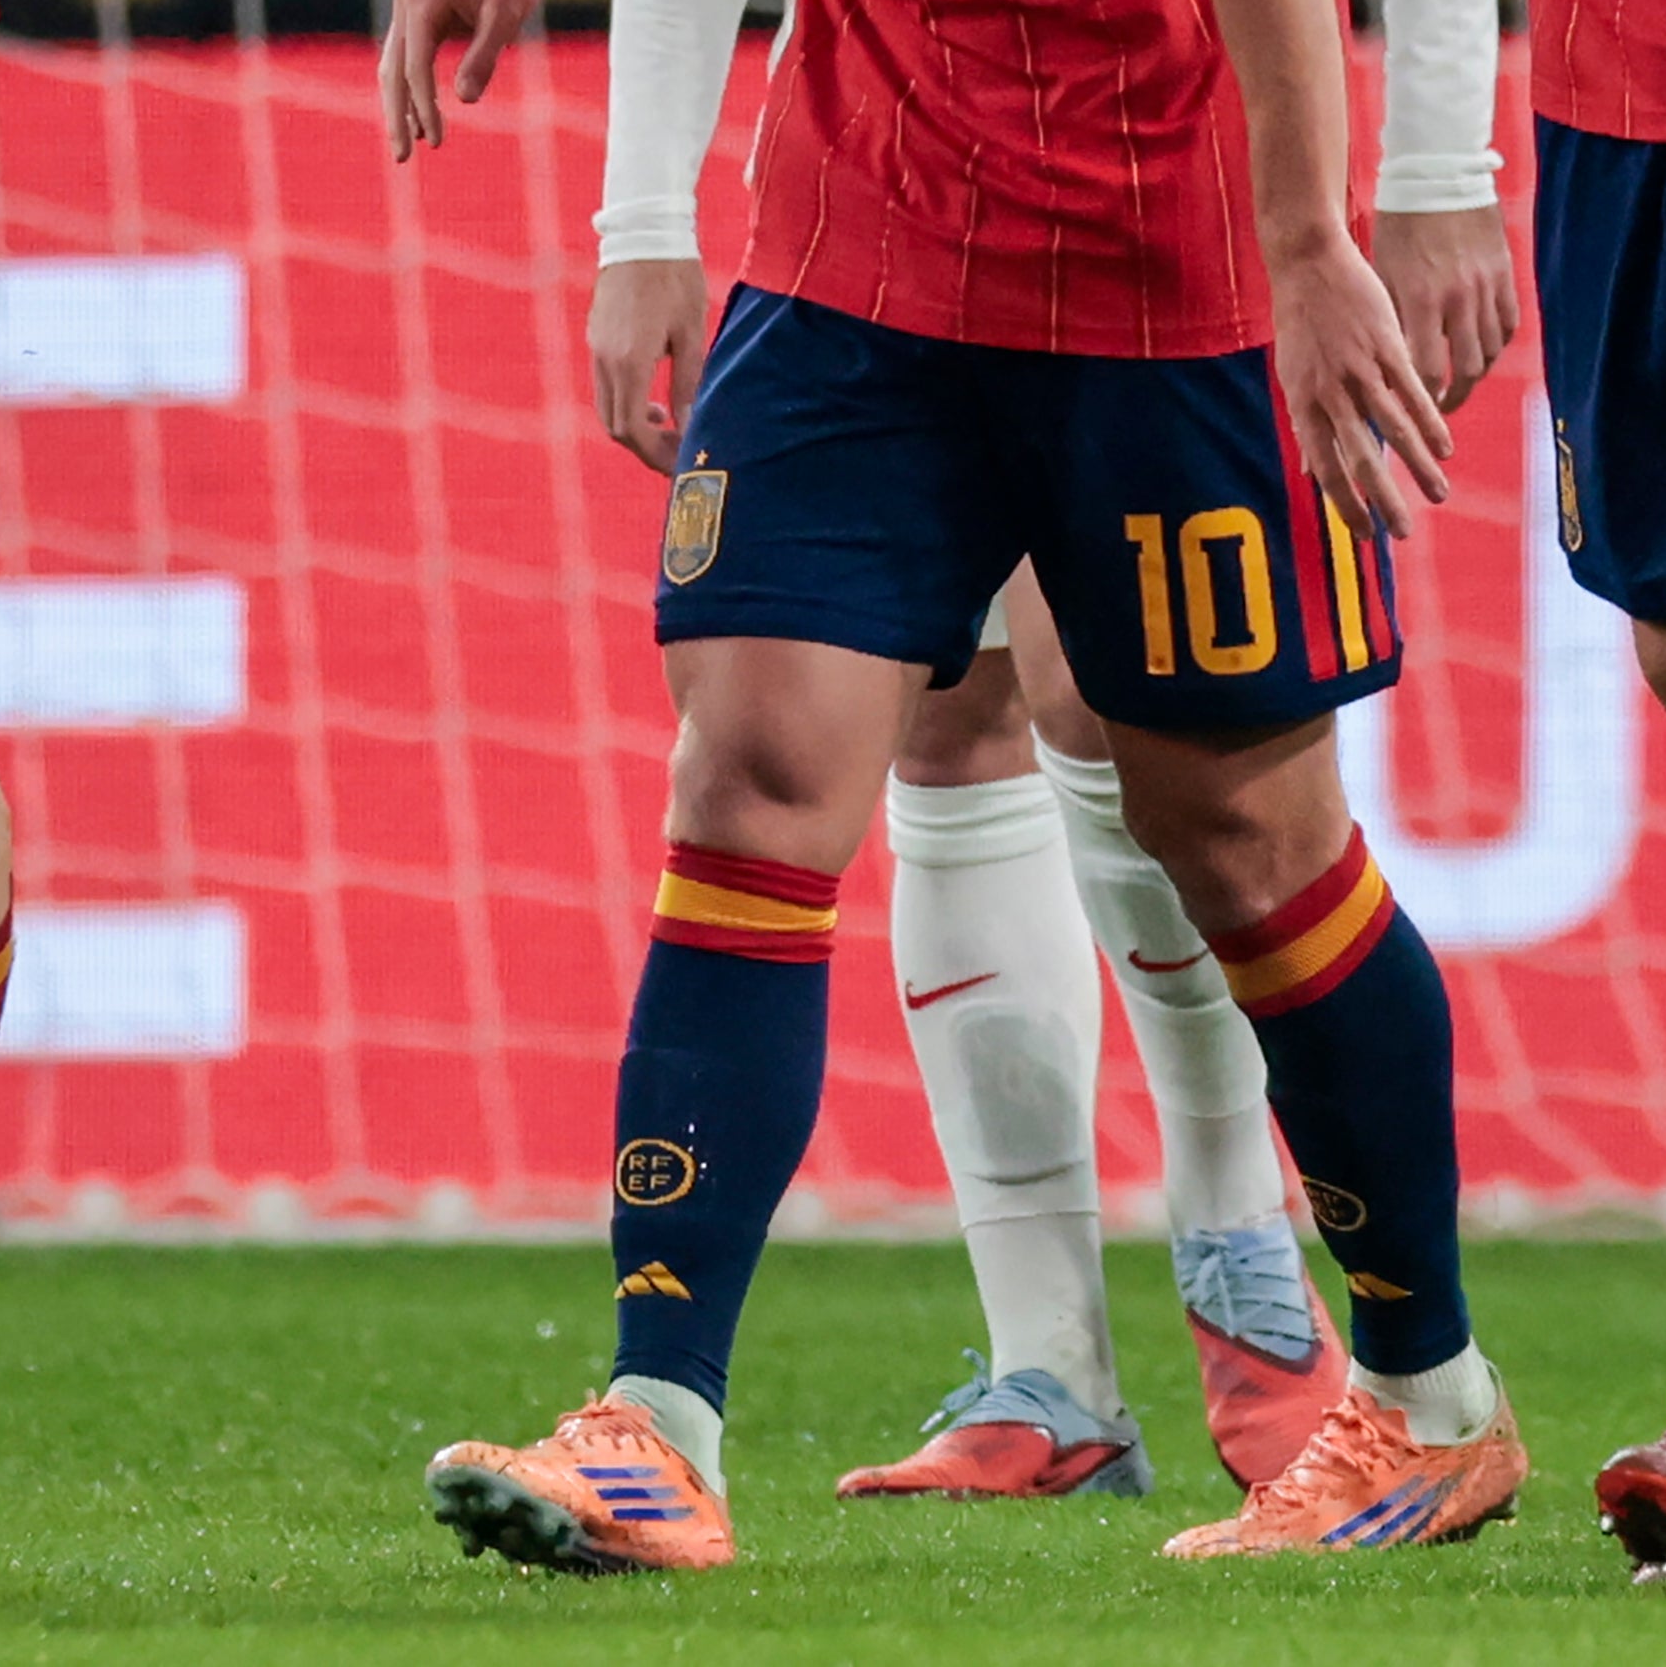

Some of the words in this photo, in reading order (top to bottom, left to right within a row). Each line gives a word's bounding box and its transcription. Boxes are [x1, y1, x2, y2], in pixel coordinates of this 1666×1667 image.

[1123, 505, 1278, 677] 10
[629, 1153, 673, 1171] RF
[628, 1173, 672, 1192] EF
